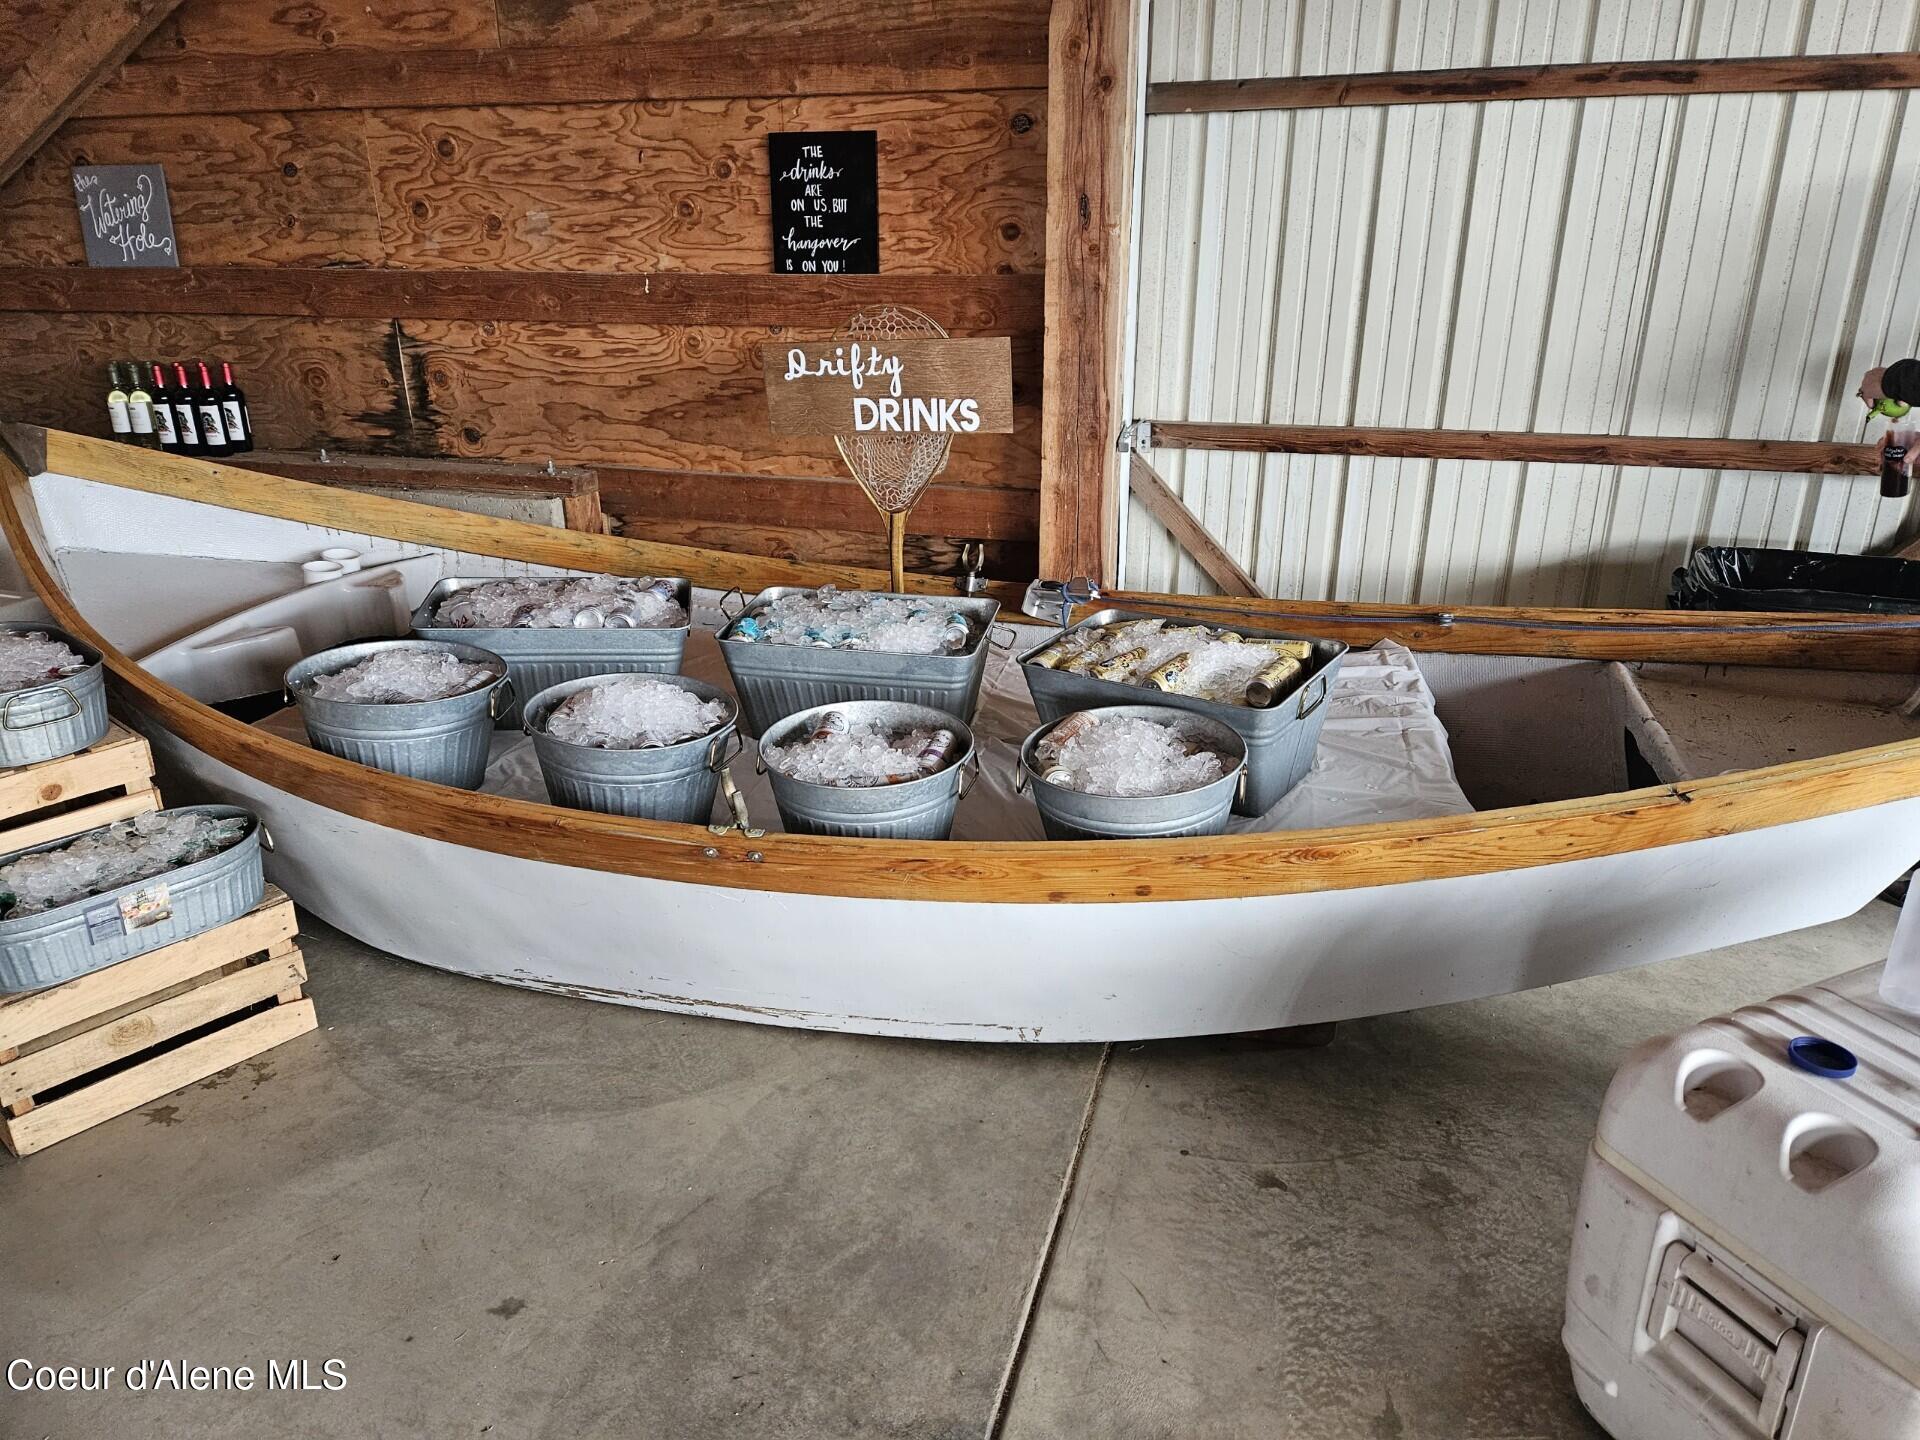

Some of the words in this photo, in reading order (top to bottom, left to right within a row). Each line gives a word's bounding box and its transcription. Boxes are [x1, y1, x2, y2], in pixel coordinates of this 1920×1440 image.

[802, 145, 824, 158] THE
[779, 158, 844, 182] drinks
[73, 174, 98, 192] the
[804, 184, 823, 197] ARE
[80, 174, 153, 239] Watering
[790, 198, 805, 211] ON
[832, 198, 848, 213] BUT
[803, 215, 824, 228] THE
[108, 223, 172, 262] Hole
[781, 227, 861, 257] hangover
[785, 259, 794, 271] IS
[801, 260, 816, 272] ON
[784, 343, 904, 397] Drifty
[853, 397, 981, 433] DRINKS
